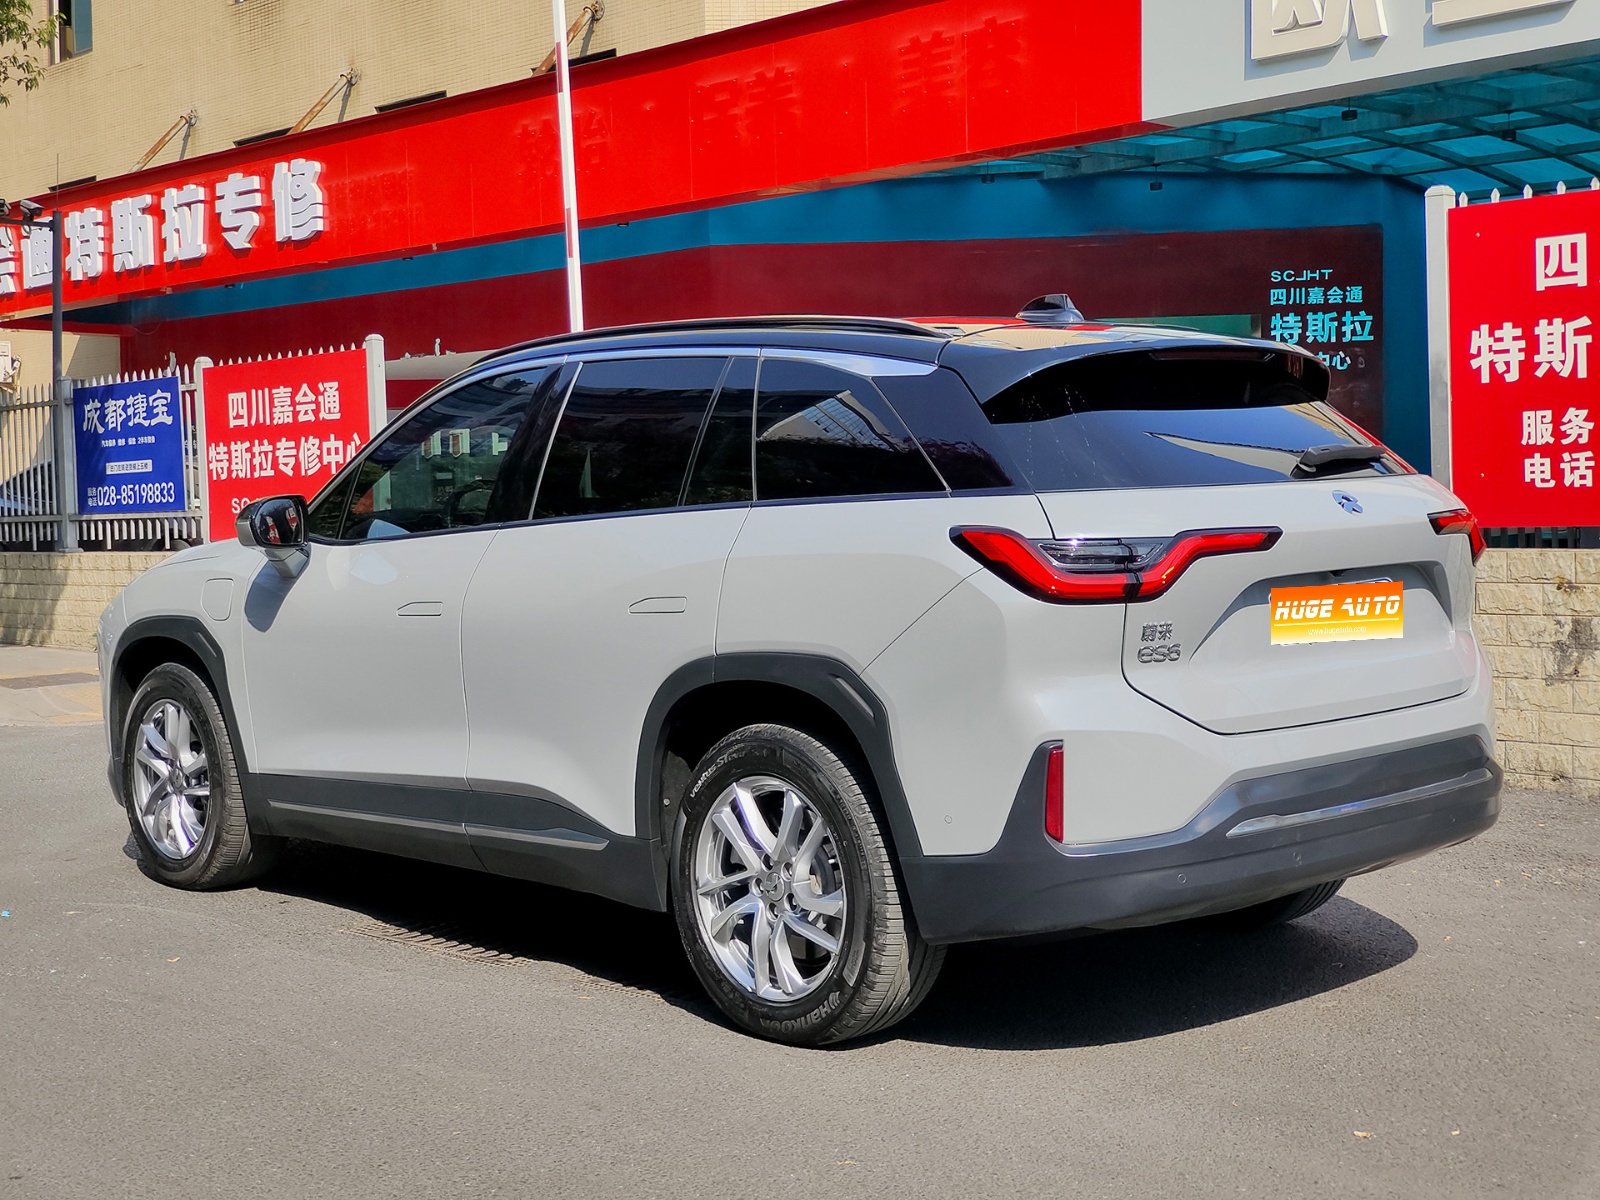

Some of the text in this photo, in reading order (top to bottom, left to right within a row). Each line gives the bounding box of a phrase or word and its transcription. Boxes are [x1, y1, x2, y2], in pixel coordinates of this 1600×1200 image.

[1535, 233, 1588, 291] 四
[1270, 286, 1363, 305] 四川嘉会通
[1270, 310, 1374, 344] 特斯拉
[1469, 316, 1593, 384] 特斯
[83, 388, 174, 433] 成都捷宝
[228, 381, 341, 429] 四川嘉会通
[1521, 408, 1595, 446] 服务
[1524, 452, 1595, 488] 电话
[97, 482, 175, 507] 028-85198833
